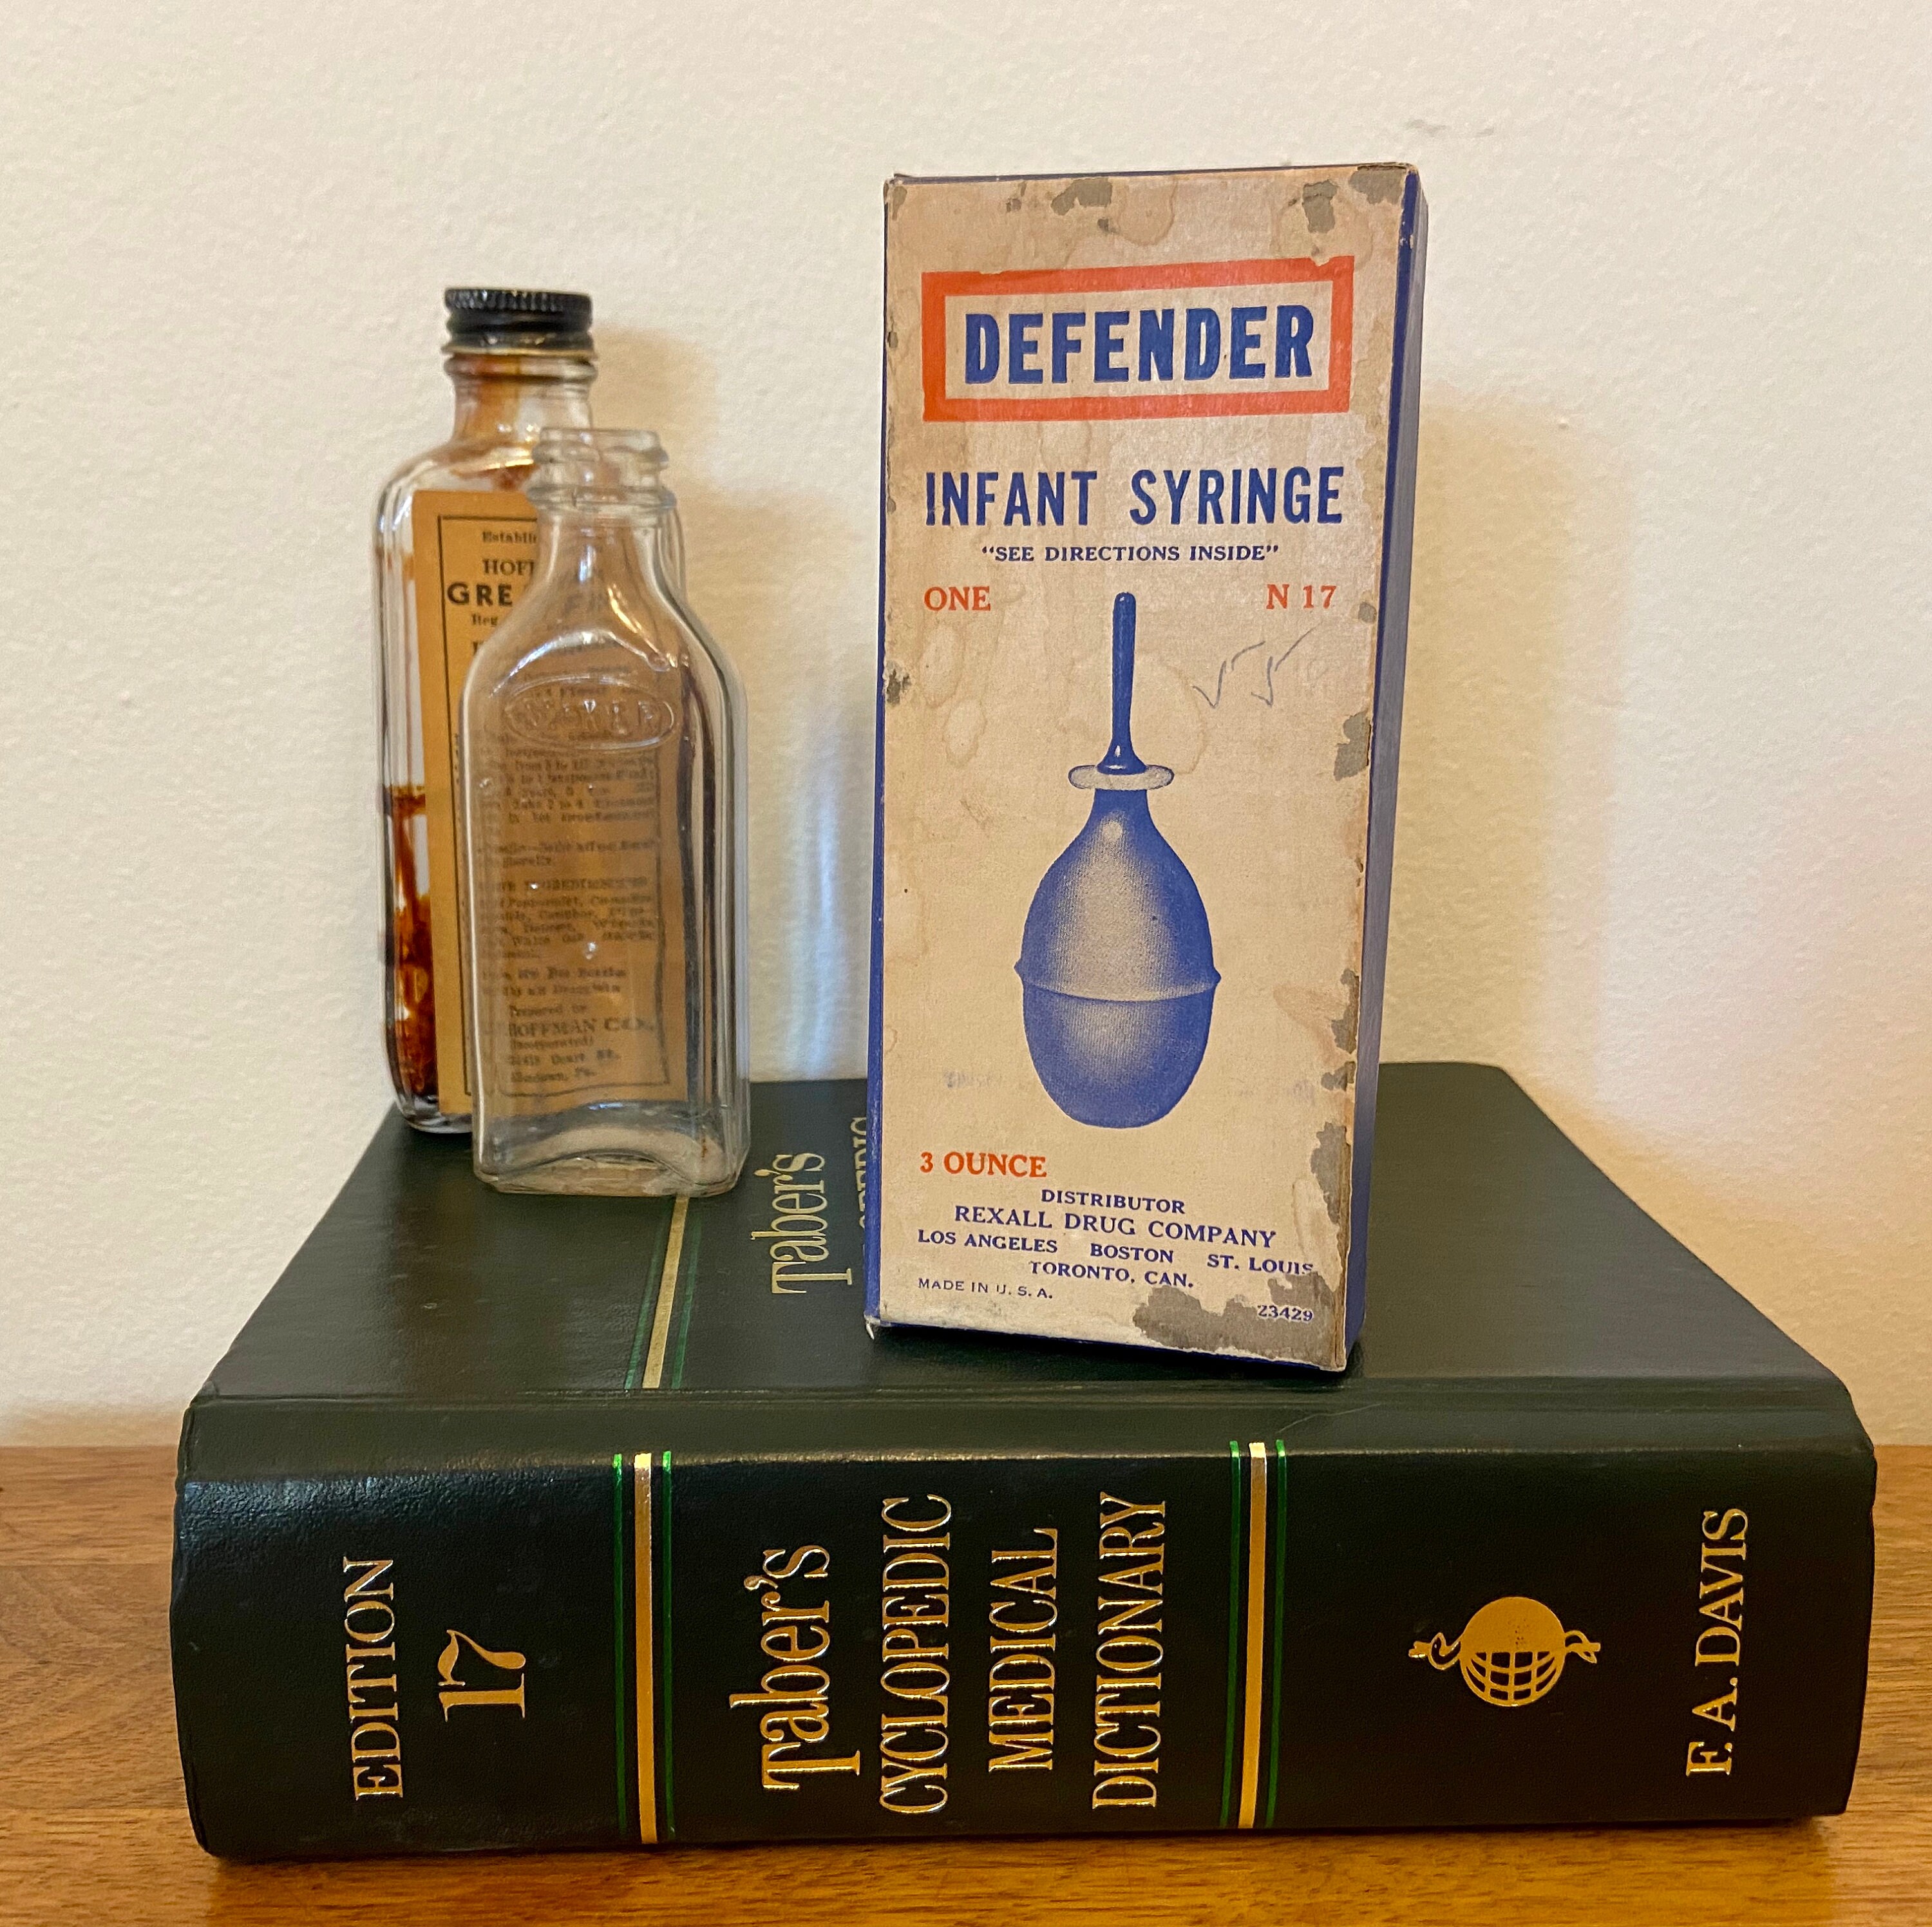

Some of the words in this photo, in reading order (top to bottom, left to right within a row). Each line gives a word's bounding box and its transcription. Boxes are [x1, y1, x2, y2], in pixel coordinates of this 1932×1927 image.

[964, 304, 1314, 385] DEFENDER
[925, 471, 1098, 526] INFANT
[1129, 466, 1345, 525] SYRINGE
[1045, 546, 1180, 562] DIRECTIONS
[923, 587, 991, 611] ONE
[1266, 584, 1289, 609] N
[1303, 585, 1336, 608] 17
[920, 1151, 934, 1173] 3
[943, 1151, 1047, 1177] OUNCE
[751, 1153, 852, 1293] Taber’s
[1041, 1189, 1185, 1214] DISTRIBUTOR
[918, 1229, 956, 1245] LOS
[965, 1233, 1058, 1253] ANGELES
[1090, 1244, 1173, 1263] BOSTON
[1208, 1254, 1240, 1270] ST.
[1249, 1257, 1313, 1275] LOUIS
[954, 1206, 1053, 1229] REXALL
[1064, 1213, 1136, 1235] DRUG
[1148, 1221, 1276, 1248] COMPANY
[918, 1278, 965, 1291] MADE
[971, 1282, 989, 1294] IN
[1028, 1260, 1135, 1284] TORONTO,
[1144, 1270, 1194, 1288] CAN.
[1257, 1305, 1313, 1321] 23429
[1694, 1508, 1749, 1667] DAVIS
[729, 1544, 860, 1790] Taber’s
[879, 1494, 952, 1814] CYCLOPEDIC
[989, 1528, 1057, 1772] MEDICAL
[1092, 1491, 1166, 1810] DICTIONARY
[342, 1556, 404, 1801] EDITION
[437, 1629, 526, 1722] 17
[1692, 1677, 1738, 1732] A.
[1685, 1741, 1734, 1778] F.
